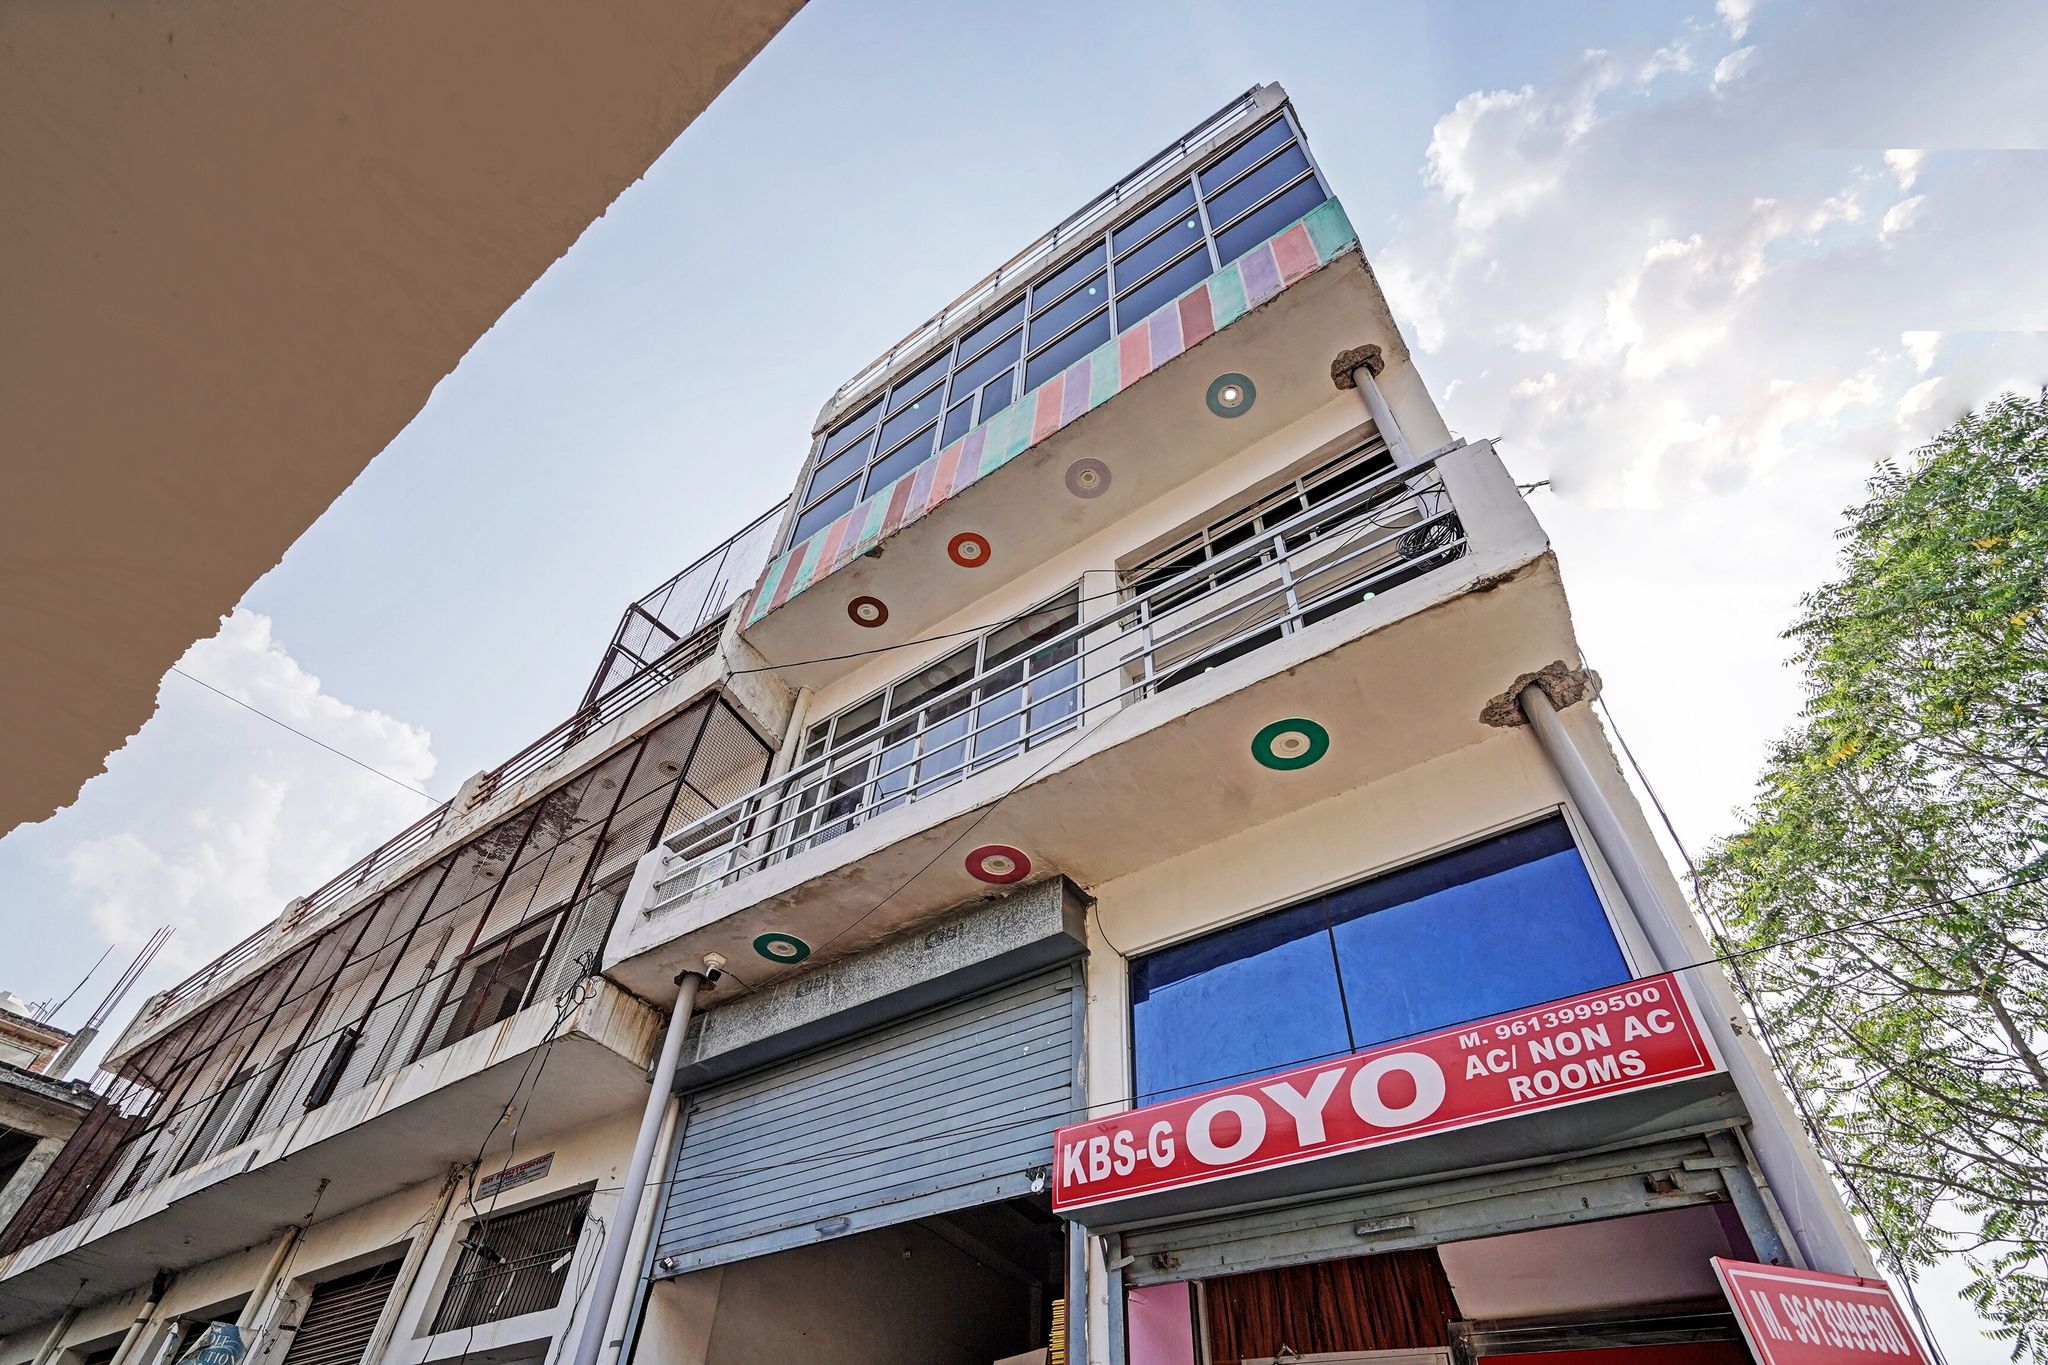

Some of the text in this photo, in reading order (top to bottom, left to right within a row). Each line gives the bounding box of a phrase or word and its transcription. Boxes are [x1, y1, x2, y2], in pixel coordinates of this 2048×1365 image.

[1458, 987, 1660, 1050] M. 9613999500
[1465, 1008, 1675, 1081] AC/ NON AC
[1507, 1049, 1647, 1103] ROOMS
[1063, 1050, 1447, 1189] KBS-G OYO
[1749, 1289, 1912, 1357] M. 9613999500
